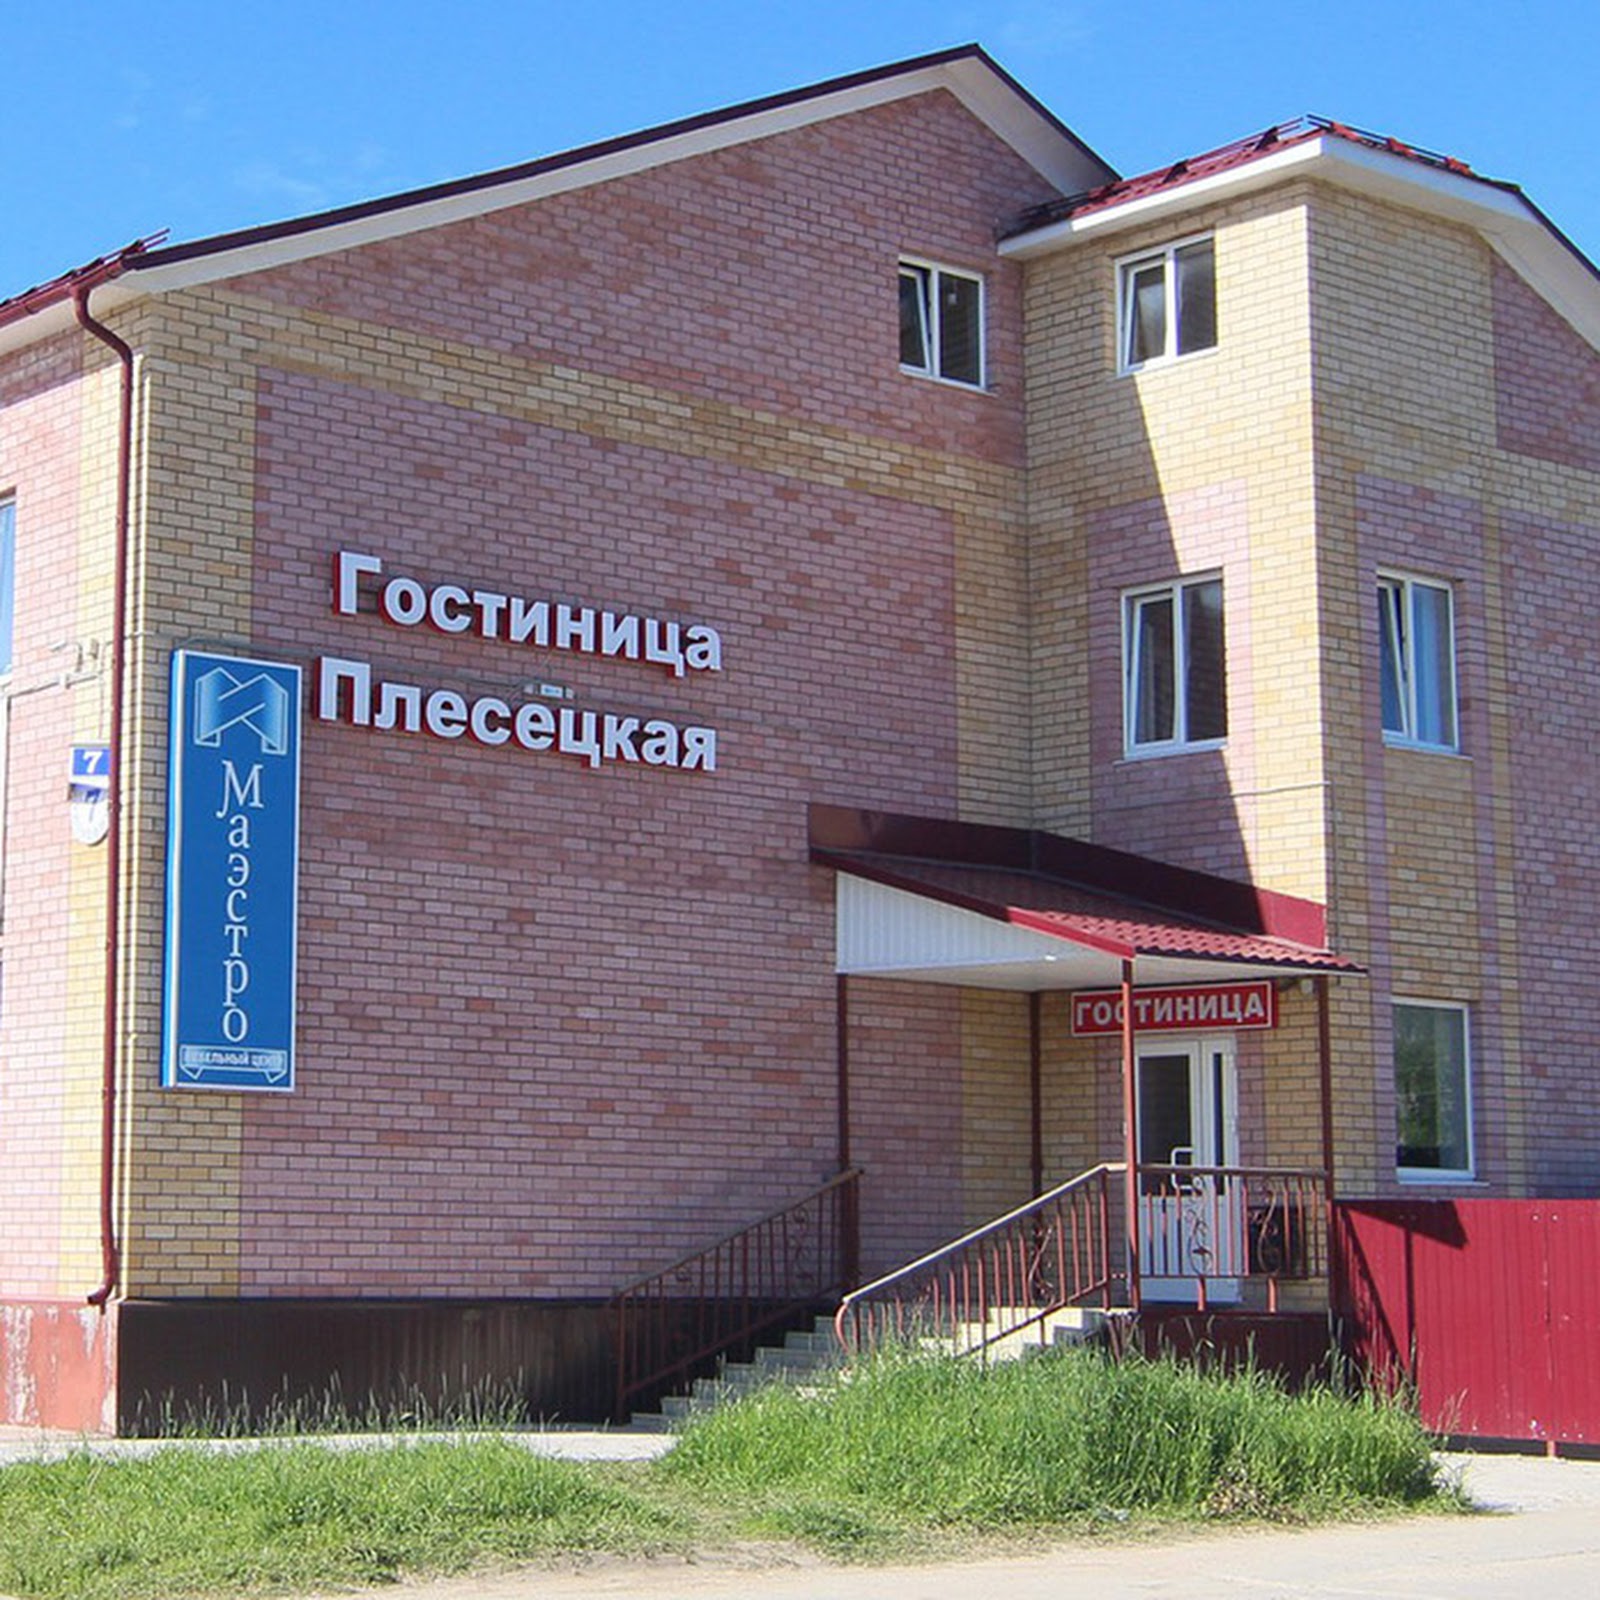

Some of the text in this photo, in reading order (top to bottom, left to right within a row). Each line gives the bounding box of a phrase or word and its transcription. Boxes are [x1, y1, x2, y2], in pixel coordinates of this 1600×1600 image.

[337, 551, 722, 677] Гостиница
[83, 750, 103, 774] 7
[318, 656, 717, 772] Плесецкая
[216, 760, 264, 1043] Маэстро
